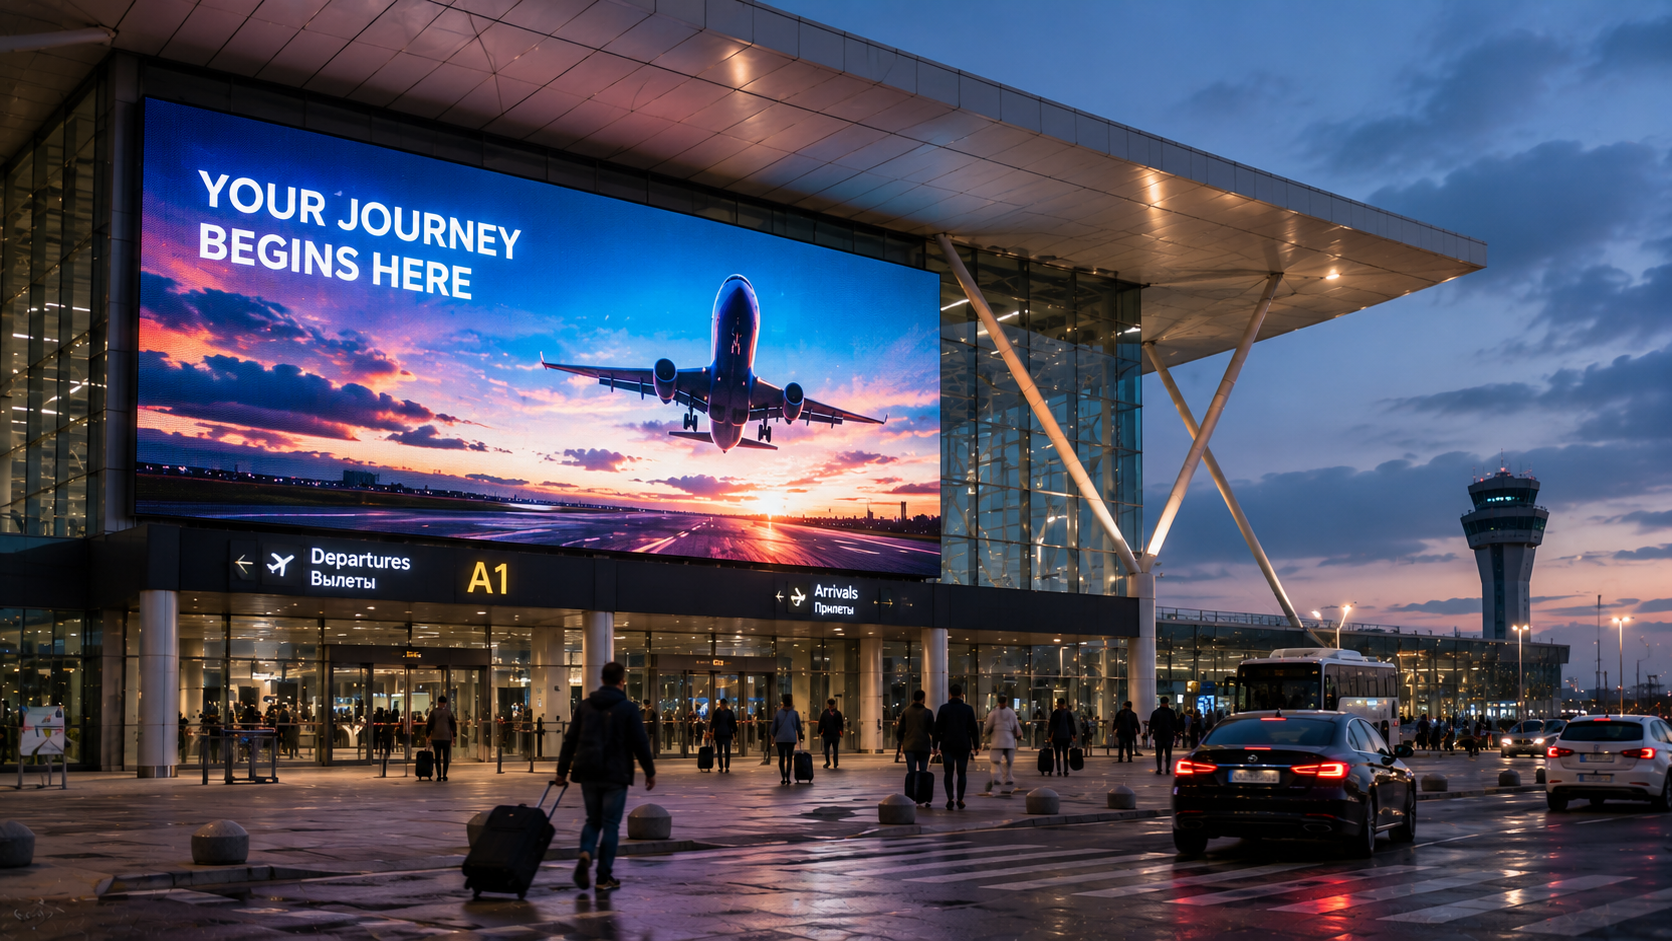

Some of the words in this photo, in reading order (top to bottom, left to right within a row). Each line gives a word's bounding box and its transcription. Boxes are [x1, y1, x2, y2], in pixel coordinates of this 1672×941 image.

[198, 169, 326, 227] YOUR
[337, 198, 522, 260] JOURNEY
[199, 222, 360, 282] BEGINS
[372, 251, 472, 300] HERE
[311, 547, 411, 571] Departures
[311, 570, 376, 589] Вылеты
[467, 561, 507, 595] A1
[814, 583, 859, 600] Arrivals
